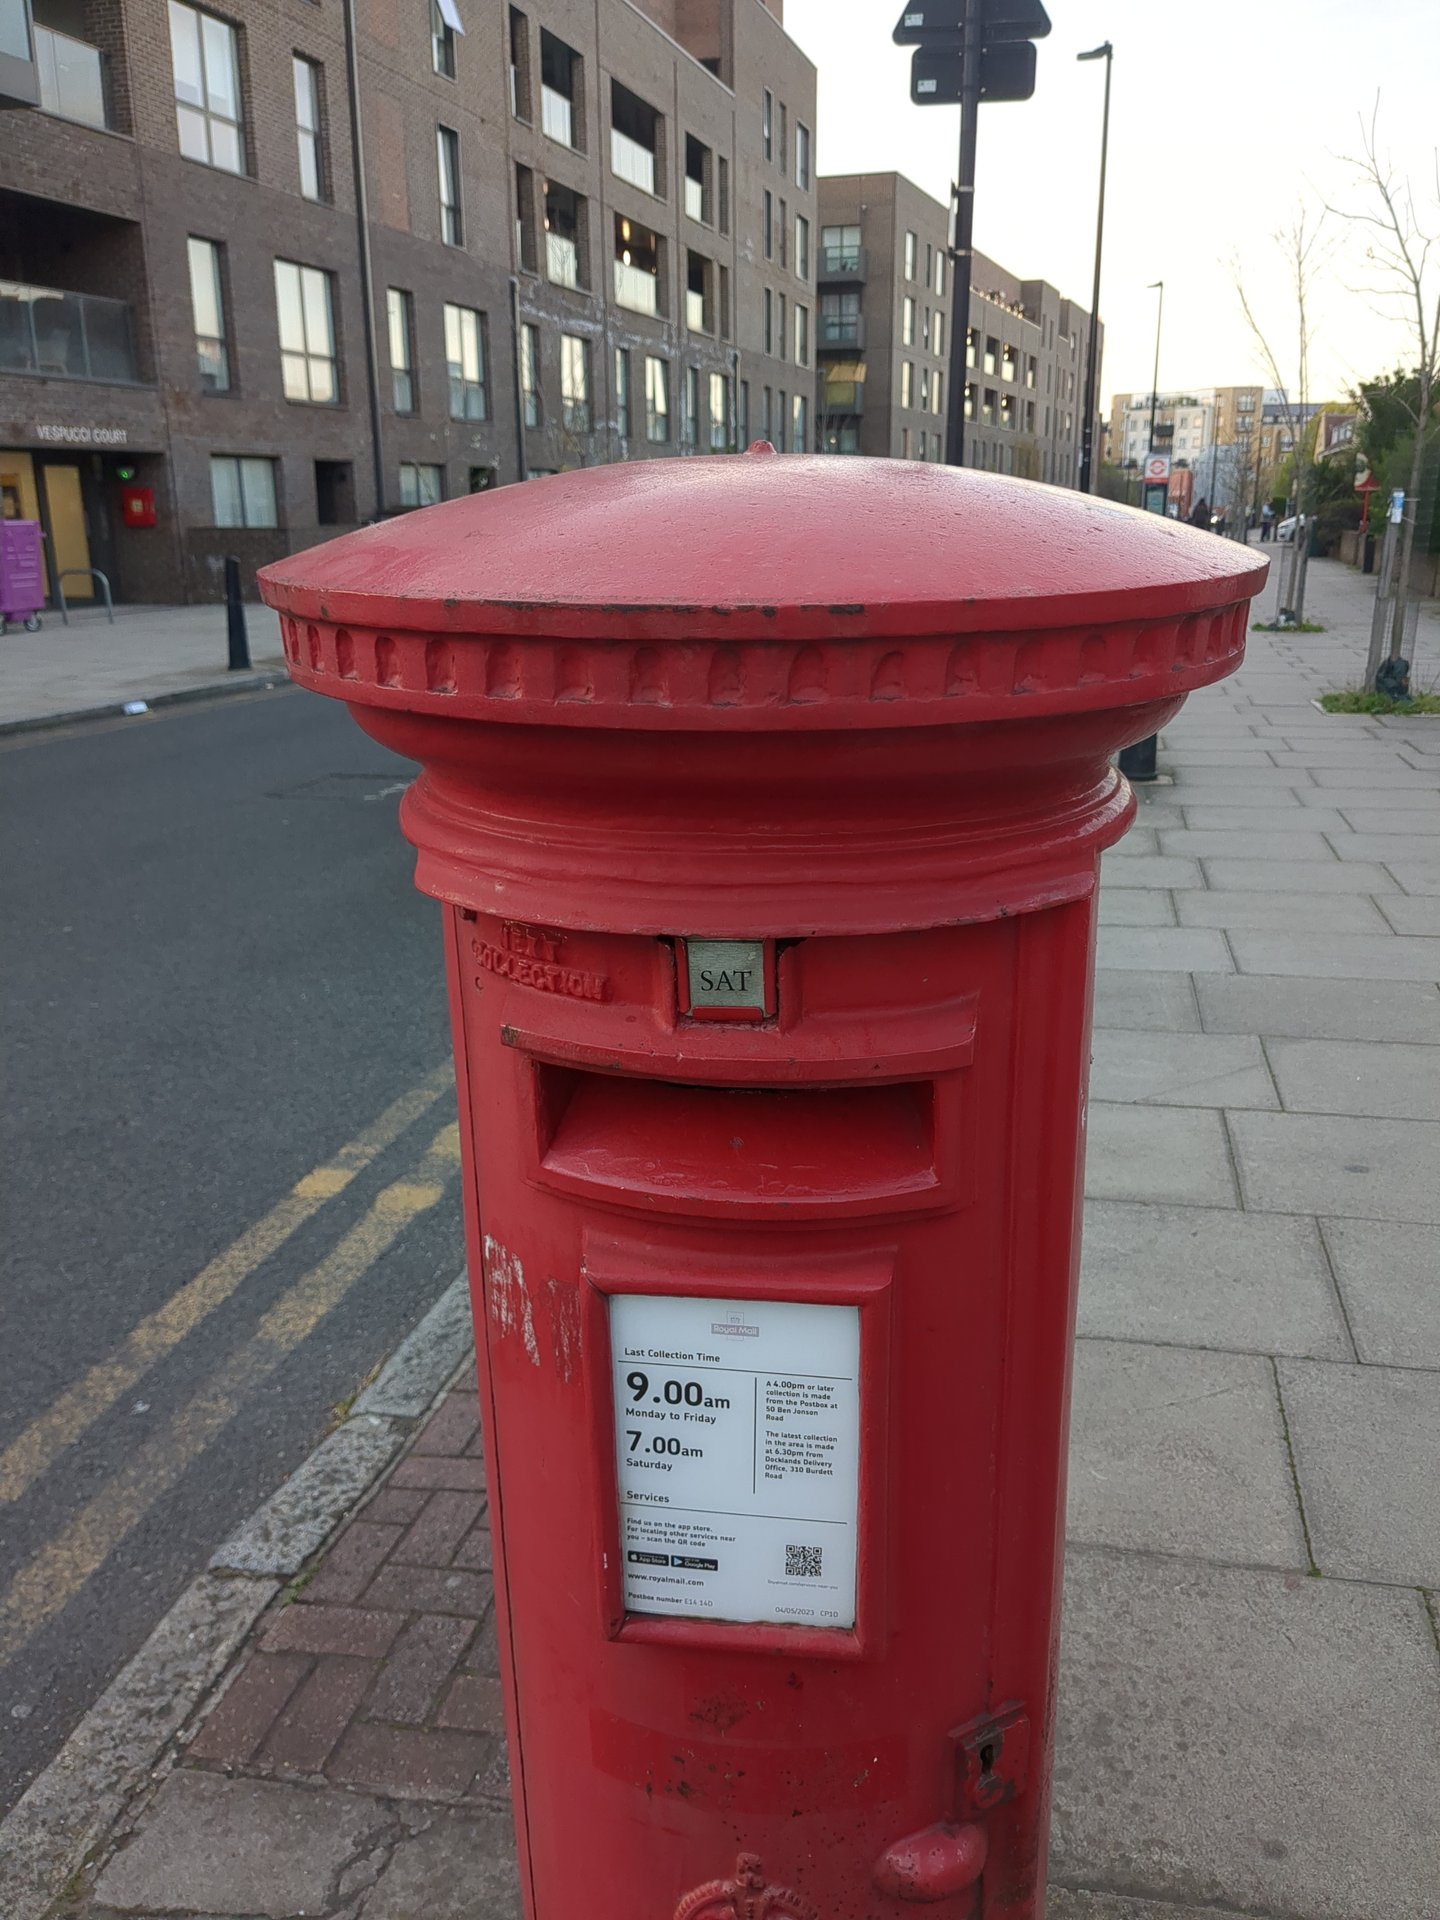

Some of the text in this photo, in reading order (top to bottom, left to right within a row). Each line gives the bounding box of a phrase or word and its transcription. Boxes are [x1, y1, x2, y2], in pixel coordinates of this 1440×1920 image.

[36, 425, 127, 444] VESPUCCI COURT
[700, 970, 752, 992] SAT
[714, 1325, 757, 1335] Royal Mail
[625, 1347, 721, 1362] Last Collection Time
[626, 1371, 730, 1409] 9.00am
[773, 1381, 805, 1390] 4.00pm
[817, 1384, 835, 1392] later
[766, 1390, 800, 1398] collection
[800, 1400, 828, 1409] Postbox
[626, 1408, 716, 1425] Monday to Friday
[777, 1406, 791, 1414] Ben
[793, 1407, 819, 1416] Jonson
[766, 1430, 838, 1442] The latest collection
[626, 1430, 703, 1457] 7.00am
[815, 1443, 835, 1451] made
[774, 1449, 804, 1458] 6.30pm
[626, 1458, 673, 1472] Saturday
[765, 1456, 833, 1468] Docklands Delivery
[765, 1464, 788, 1472] Office,
[806, 1467, 833, 1476] Burdett
[765, 1472, 783, 1480] Road
[626, 1490, 670, 1503] Services
[627, 1517, 642, 1525] Find
[640, 1527, 668, 1536] locating
[669, 1530, 688, 1538] other
[690, 1533, 718, 1541] services
[628, 1573, 705, 1586] www.royalmail.com
[628, 1592, 655, 1601] Postbox
[656, 1596, 682, 1604] number
[775, 1606, 815, 1616] 04/05/2023
